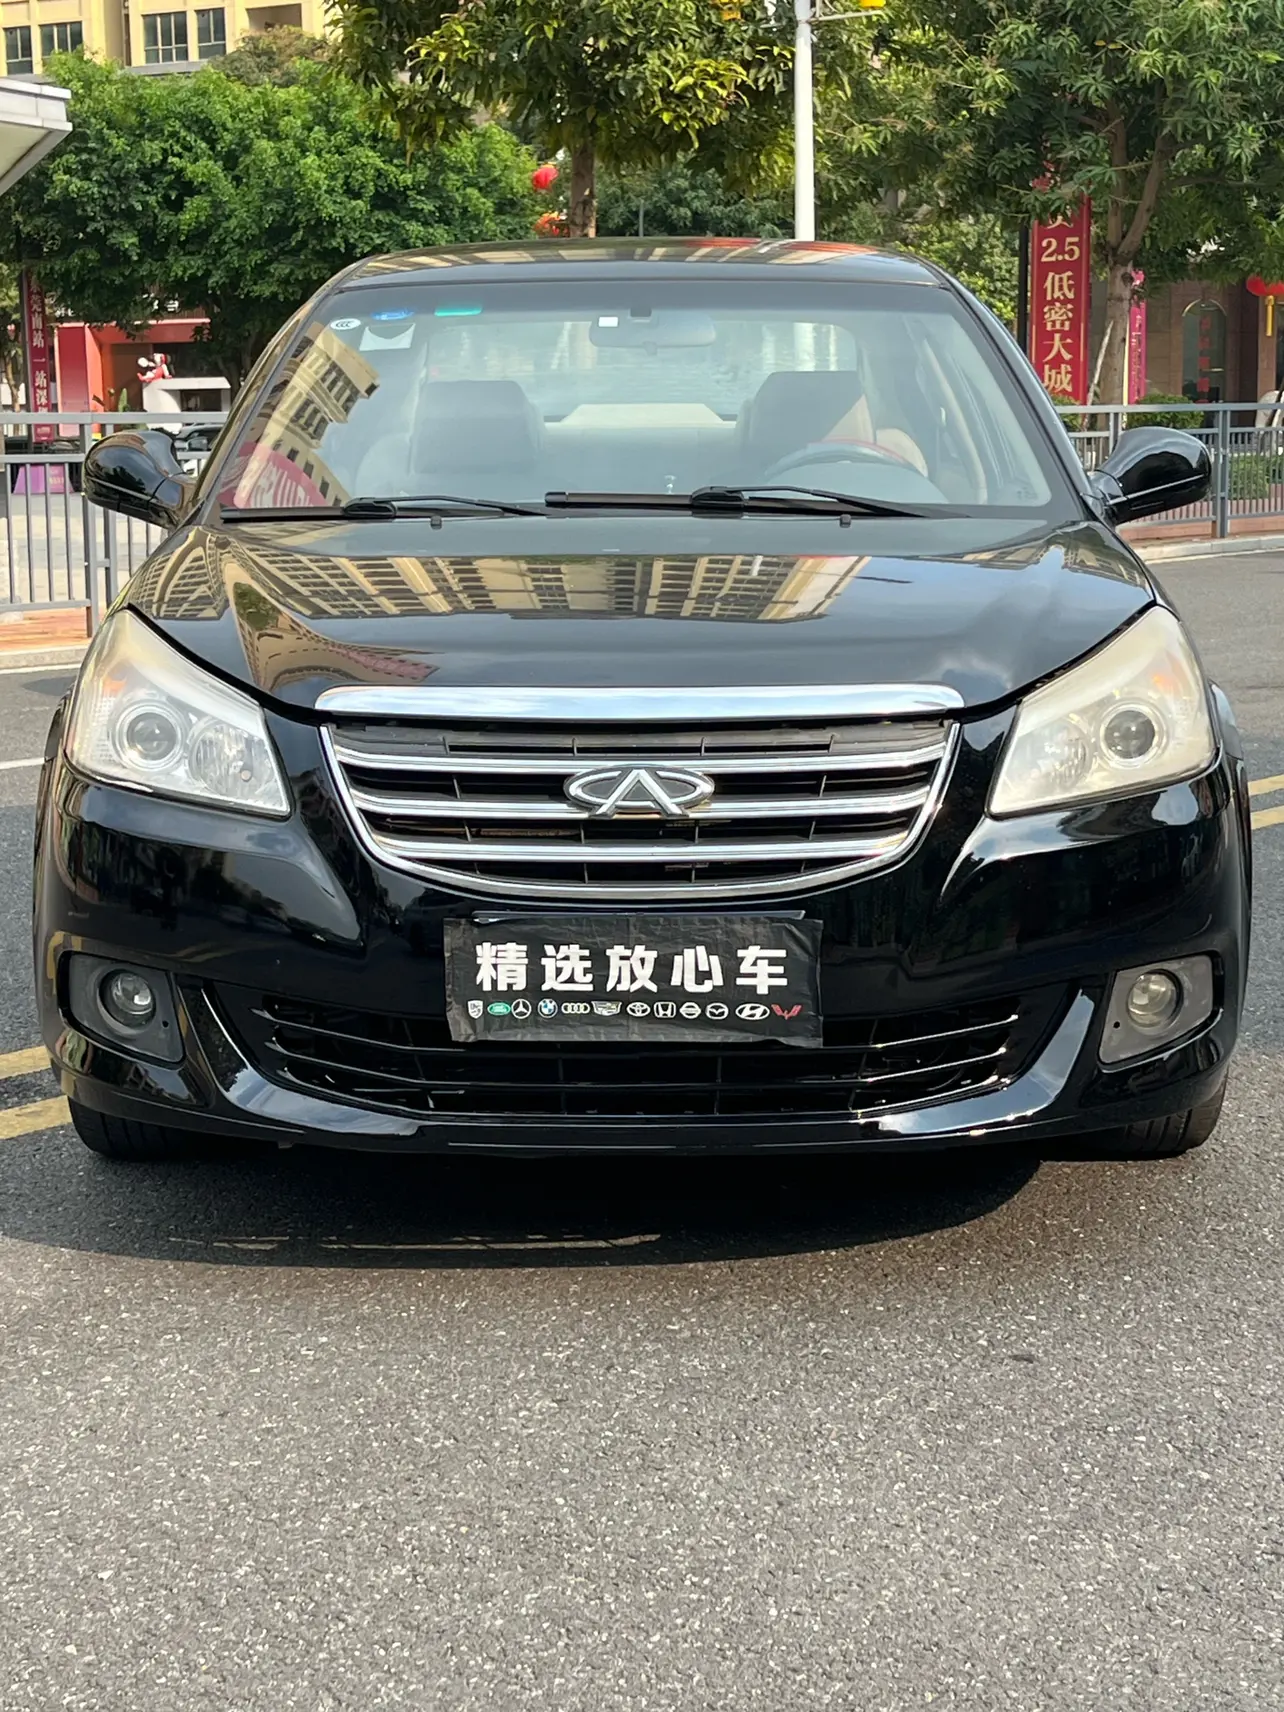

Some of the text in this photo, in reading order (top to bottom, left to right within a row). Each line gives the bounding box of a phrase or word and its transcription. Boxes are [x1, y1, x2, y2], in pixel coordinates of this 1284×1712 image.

[1041, 206, 1080, 393] 2.5低密大城
[475, 942, 788, 994] 精选放心车
